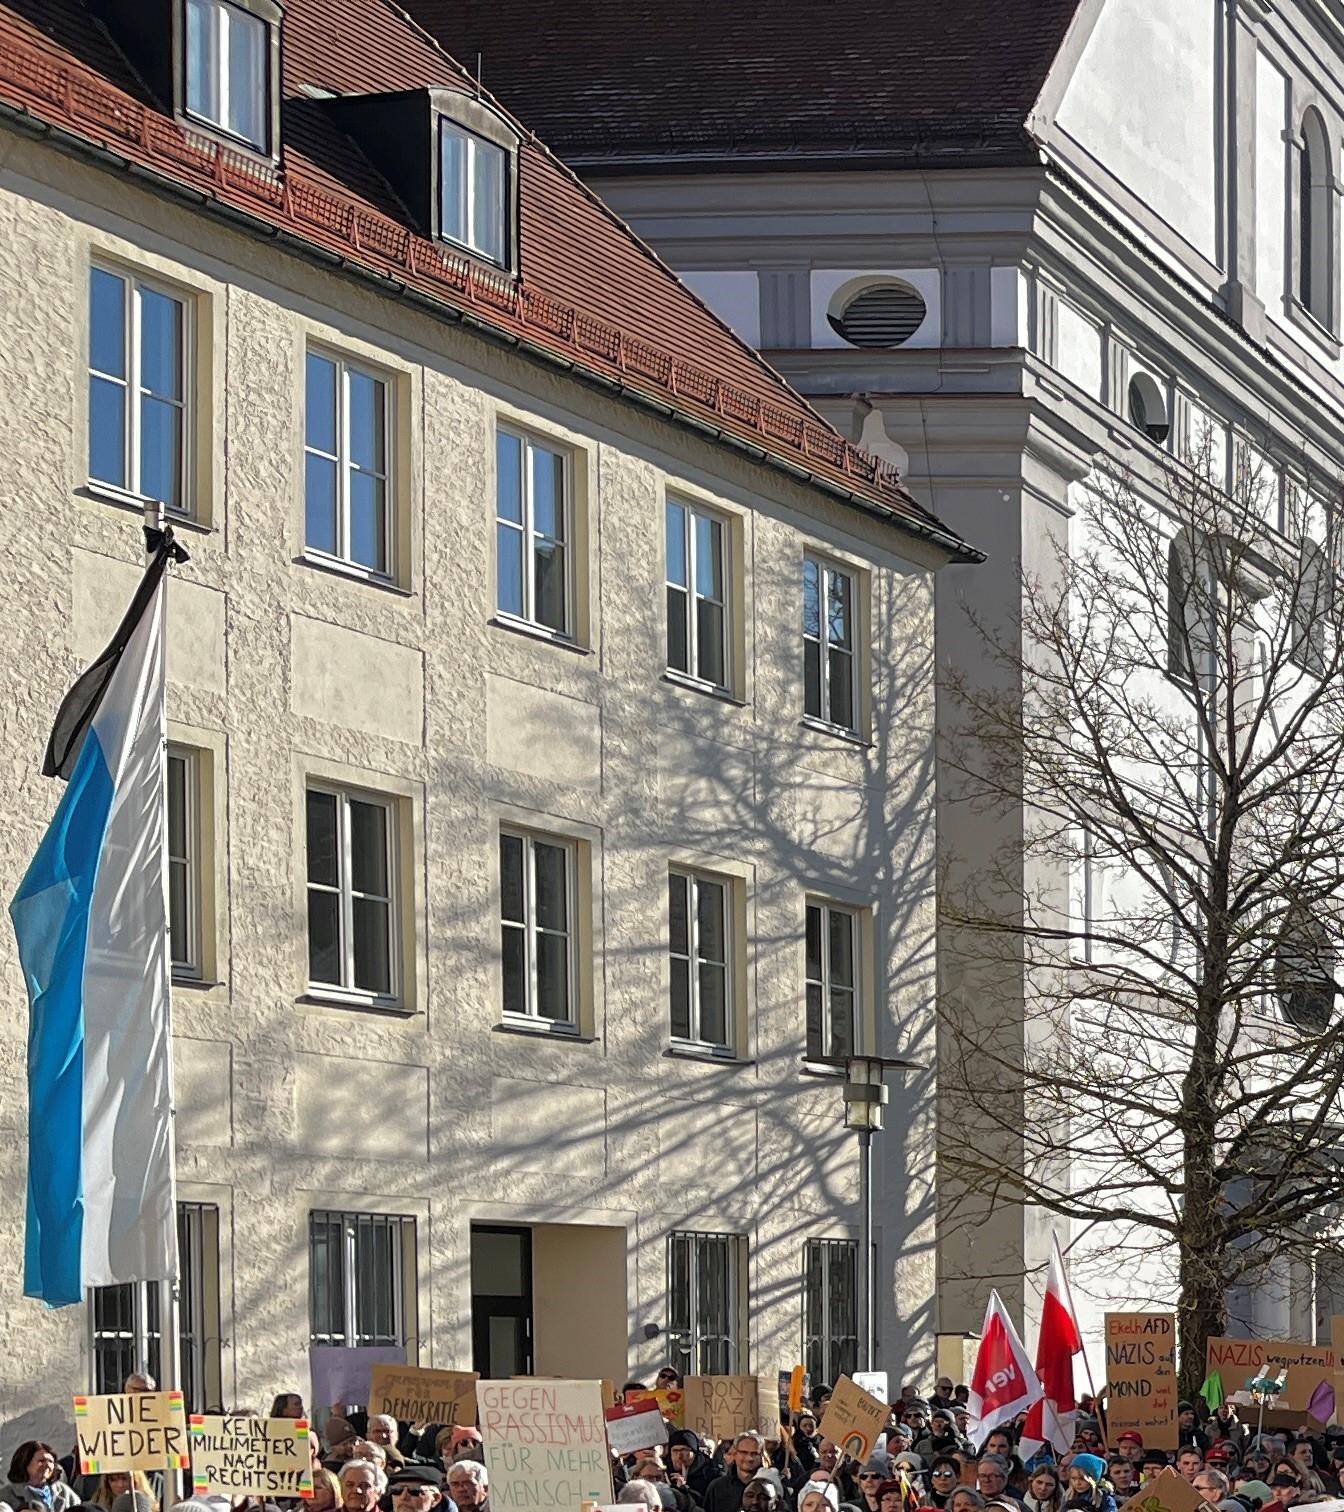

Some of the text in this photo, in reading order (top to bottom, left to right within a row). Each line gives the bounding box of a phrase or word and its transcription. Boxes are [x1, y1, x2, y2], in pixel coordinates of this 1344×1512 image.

[1107, 1341, 1154, 1366] NAZIS
[1209, 1344, 1263, 1367] NAZIS
[483, 1386, 557, 1411] GEGEN
[1109, 1379, 1151, 1398] MOND
[107, 1396, 158, 1424] NIE
[383, 1400, 460, 1424] DEMOKRATIE
[222, 1418, 267, 1437] KEIN
[486, 1410, 602, 1446] RASSISMUS
[696, 1415, 779, 1435] BE HAPPY
[80, 1427, 181, 1456] WIEDER
[193, 1434, 297, 1456] MILLIMETER
[224, 1454, 267, 1470] NACH
[490, 1443, 605, 1473] FÜR MEHR
[205, 1465, 305, 1492] RECHTS!!!
[493, 1479, 600, 1506] MENSCH-
